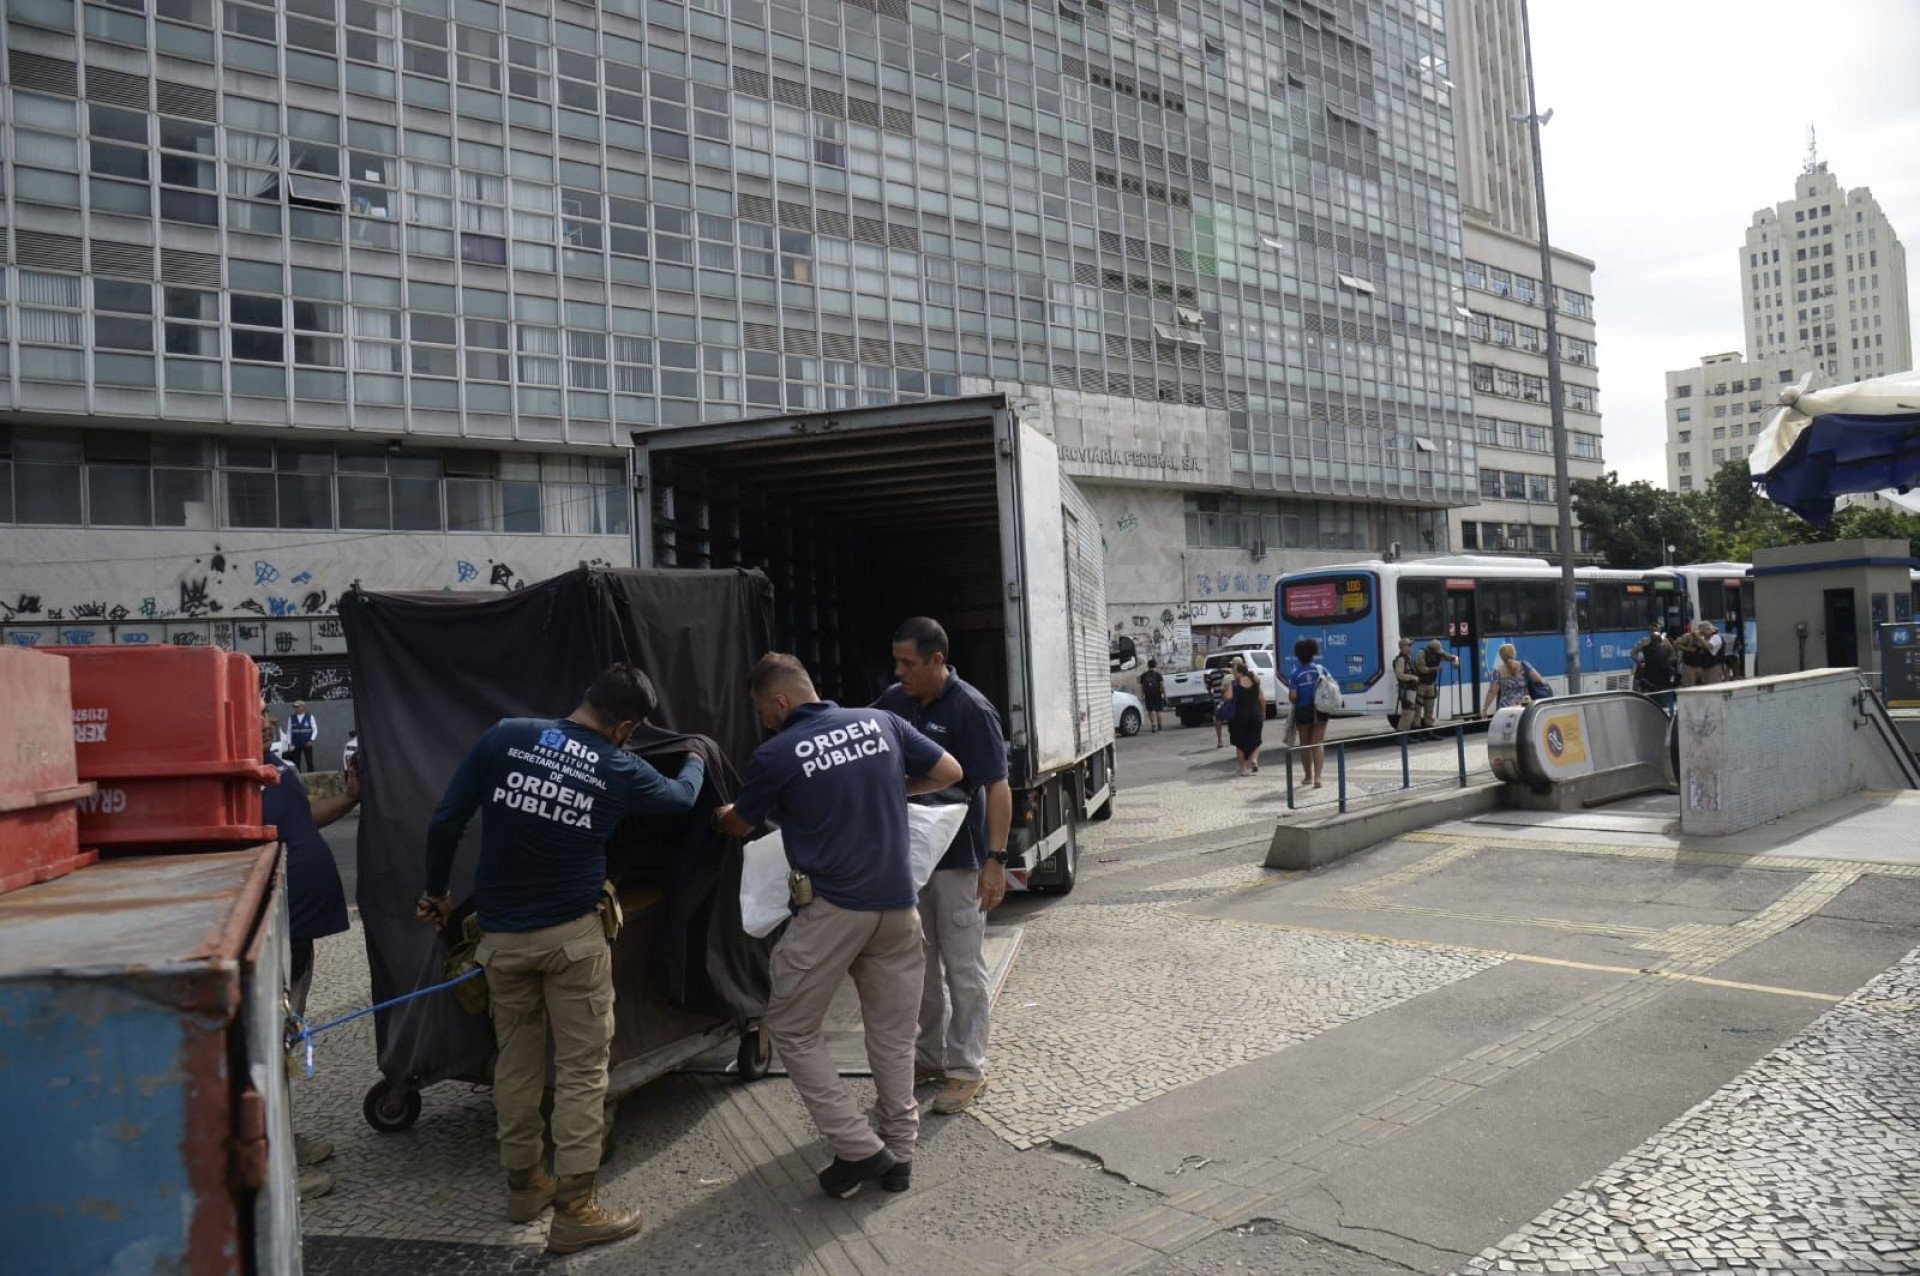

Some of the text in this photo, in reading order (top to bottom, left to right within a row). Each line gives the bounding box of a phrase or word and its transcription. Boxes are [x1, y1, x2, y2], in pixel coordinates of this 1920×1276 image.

[1125, 451, 1179, 470] FEDERAL
[563, 738, 600, 764] Rio
[794, 718, 882, 758] ORDEM
[802, 736, 890, 778] PÚBLICA
[507, 747, 607, 790] SECRETARIA MUNICIPAL
[533, 745, 595, 774] PREFEITURA
[549, 771, 564, 783] DE
[492, 787, 592, 829] PÚBLICA
[506, 771, 595, 812] ORDEM
